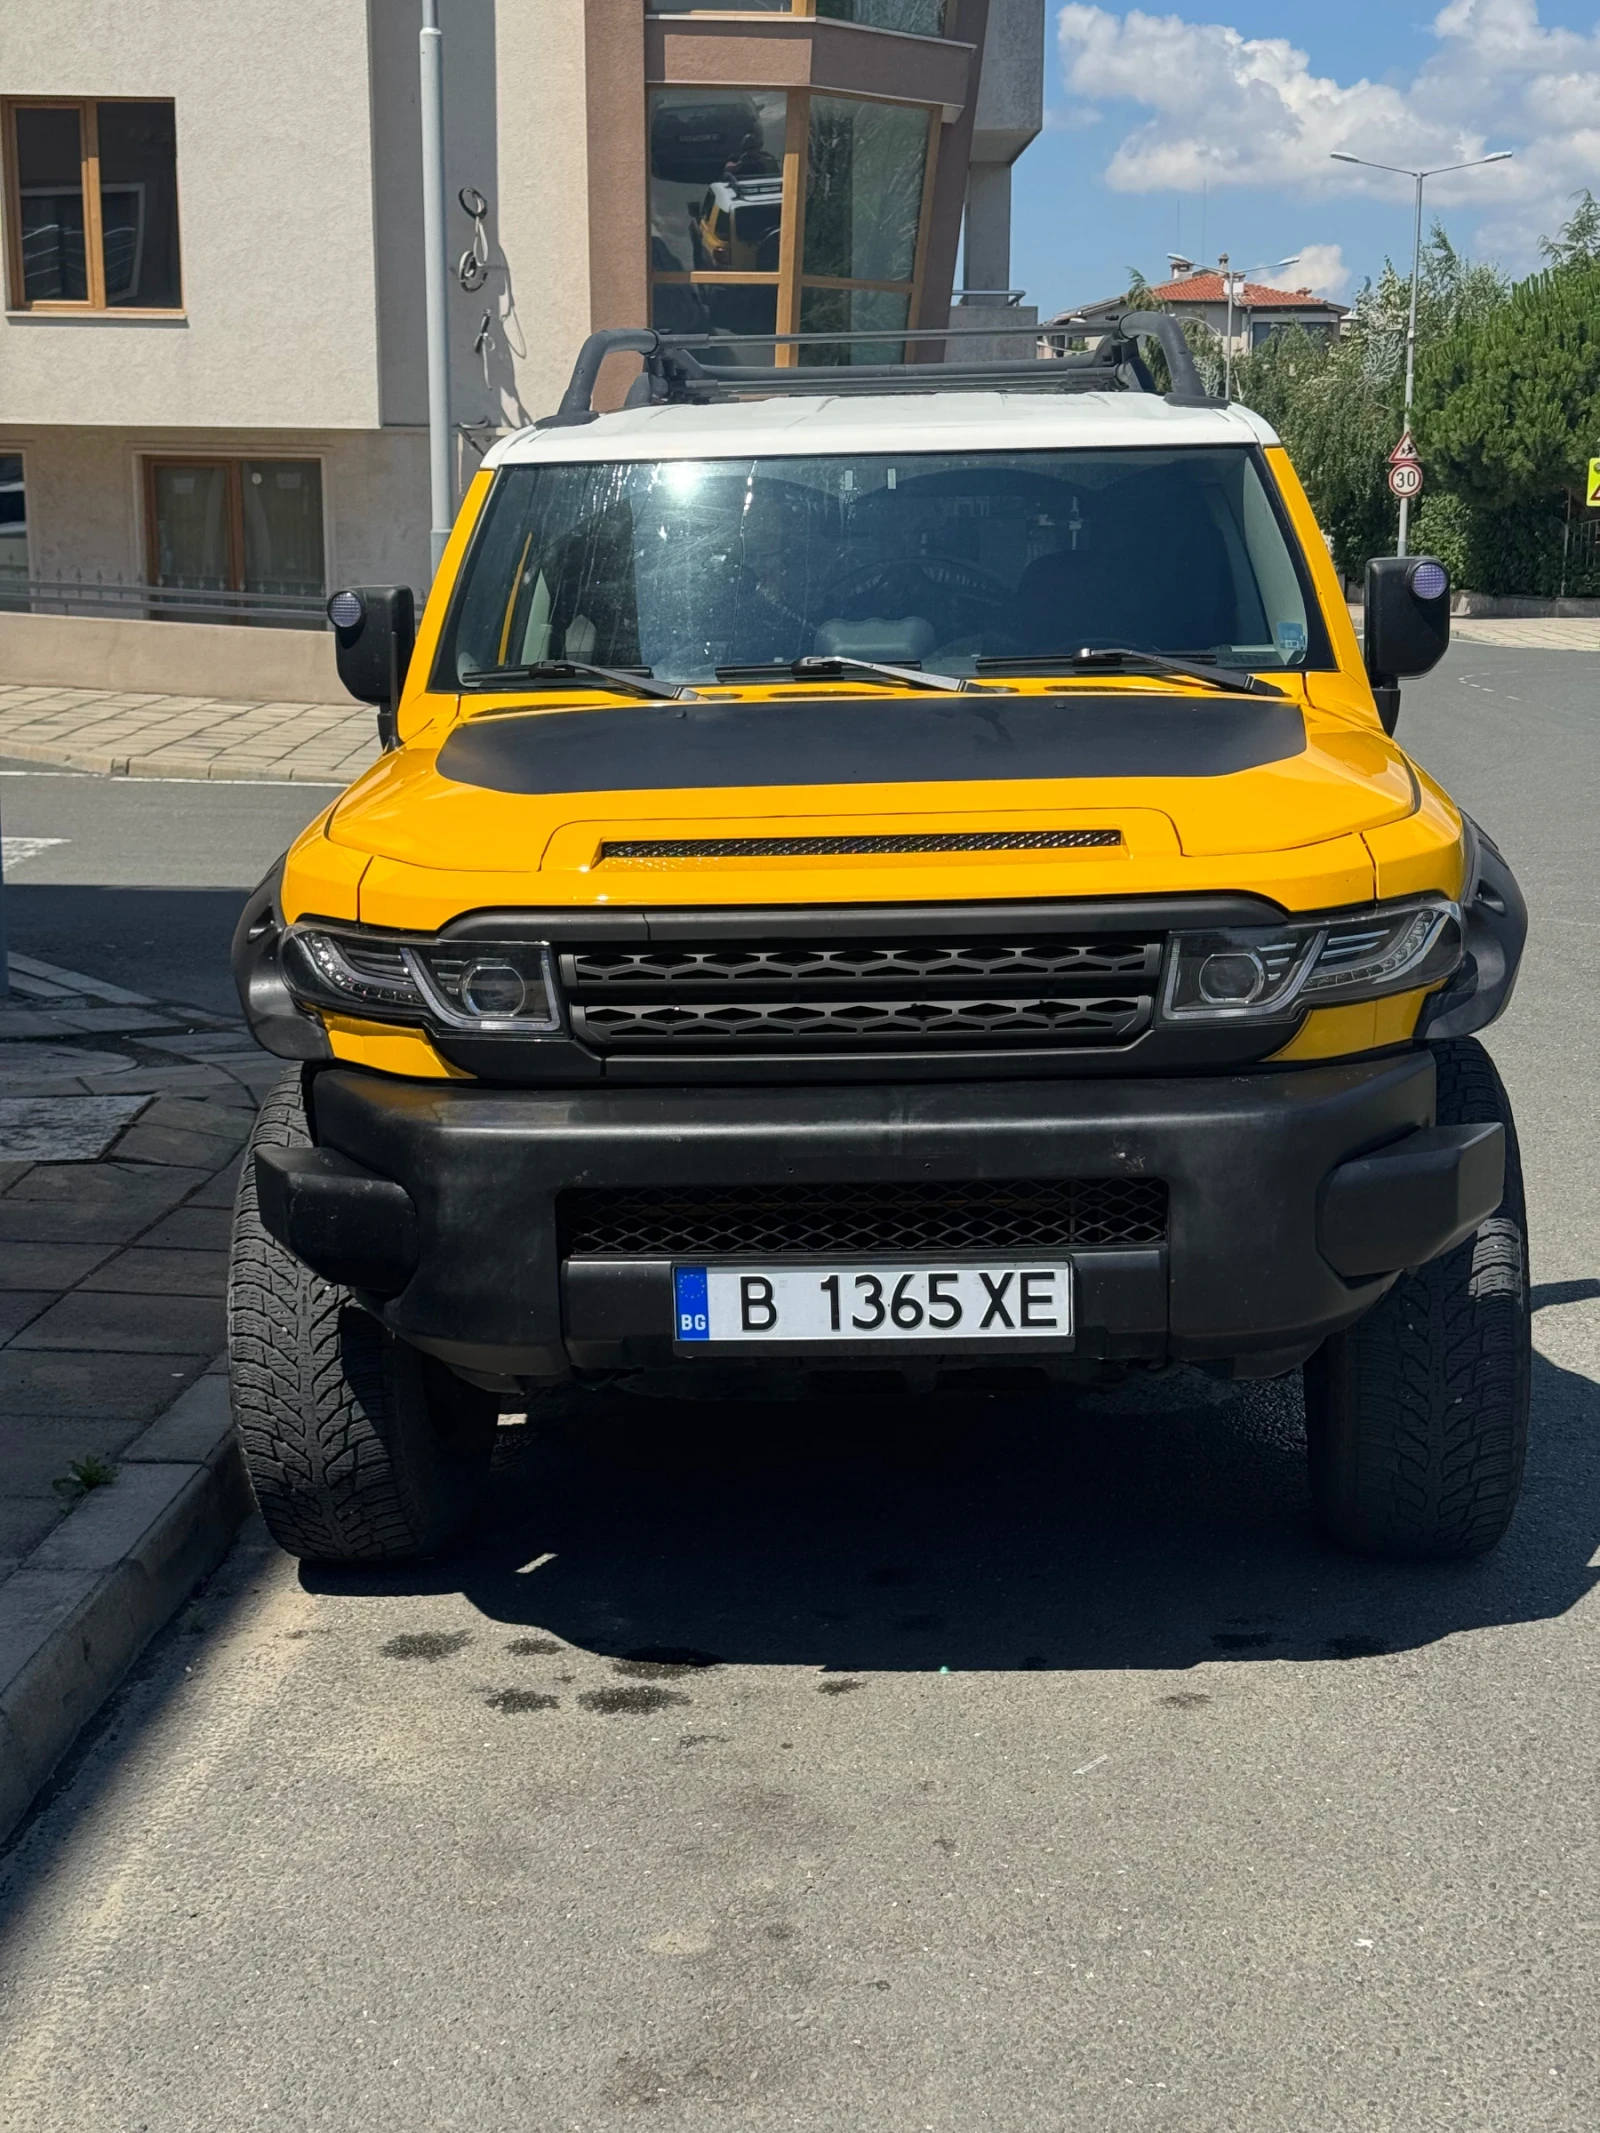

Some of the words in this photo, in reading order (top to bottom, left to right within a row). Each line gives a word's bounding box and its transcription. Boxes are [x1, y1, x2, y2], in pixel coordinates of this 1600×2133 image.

[1396, 471, 1416, 488] 30
[740, 1276, 777, 1331] B
[820, 1273, 962, 1331] 1365
[978, 1271, 1057, 1329] XE
[681, 1314, 706, 1331] BG
